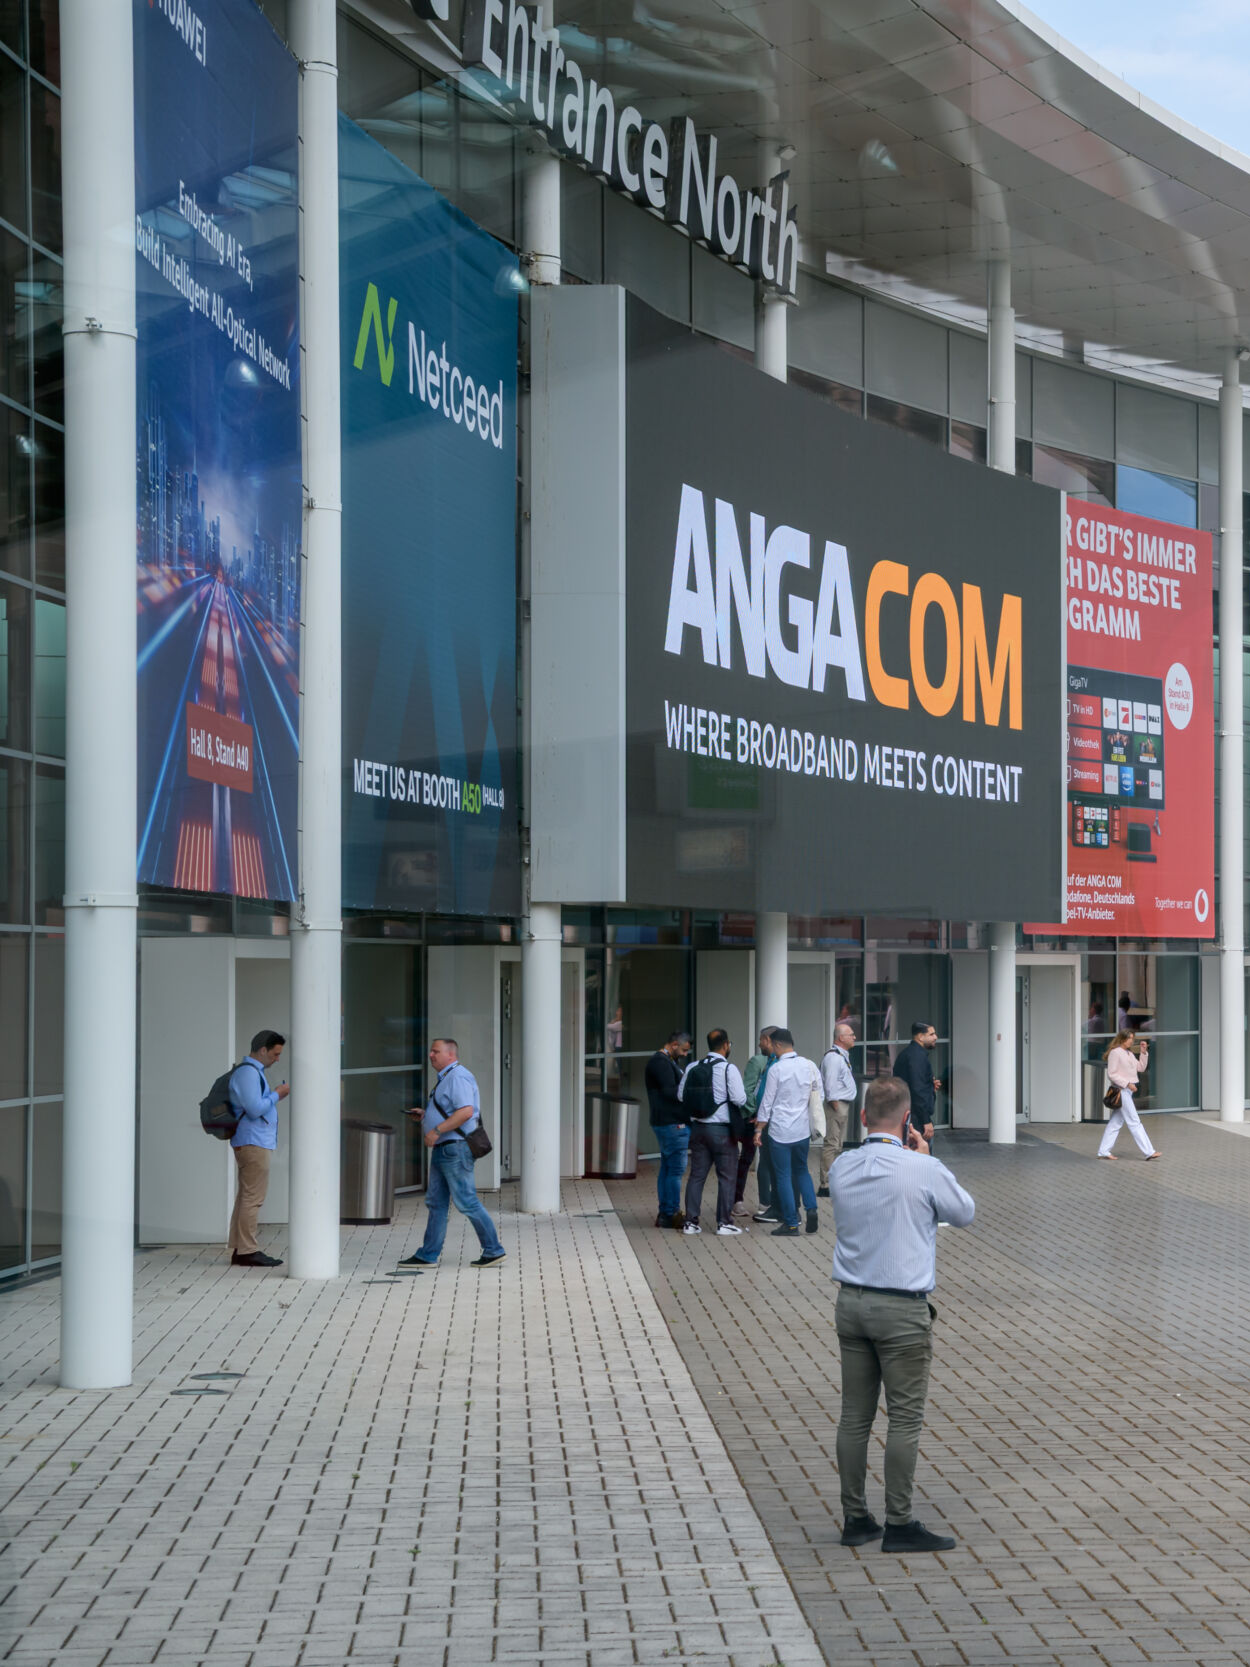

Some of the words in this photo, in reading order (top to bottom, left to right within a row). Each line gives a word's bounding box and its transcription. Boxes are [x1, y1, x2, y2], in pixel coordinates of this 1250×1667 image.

[680, 116, 798, 294] North
[178, 179, 225, 266] Embracing
[227, 233, 236, 268] AI
[238, 243, 253, 292] Era,
[136, 215, 160, 271] Build
[162, 243, 210, 318] Intelligent
[211, 292, 257, 361] All-Optical
[258, 335, 291, 391] Network
[408, 321, 503, 450] Netceed
[1137, 532, 1197, 575] IMMER
[664, 483, 866, 702] ANGA
[864, 559, 1023, 731] COM
[1067, 556, 1083, 590] H
[1087, 560, 1124, 598] DAS
[1127, 569, 1182, 610] BESTE
[1067, 597, 1141, 641] GRAMM
[1069, 675, 1088, 690] GigaTV
[190, 728, 206, 759] Hall
[207, 735, 214, 766] 8,
[215, 736, 235, 769] Stand
[236, 743, 249, 772] A40
[664, 700, 732, 761] WHERE
[736, 717, 858, 783] BROADBAND
[864, 743, 927, 792] MEETS
[931, 753, 1023, 803] CONTENT
[1073, 737, 1100, 750] Videothek
[354, 758, 388, 798] MEET
[389, 766, 406, 802] US
[407, 770, 422, 804] AT
[423, 772, 460, 811] BOOTH
[462, 781, 482, 814] A50
[1073, 768, 1099, 783] Streaming
[1067, 873, 1075, 886] uf
[1087, 875, 1106, 888] ANGA
[1106, 875, 1122, 889] COM
[1094, 892, 1135, 905] Deutschlands
